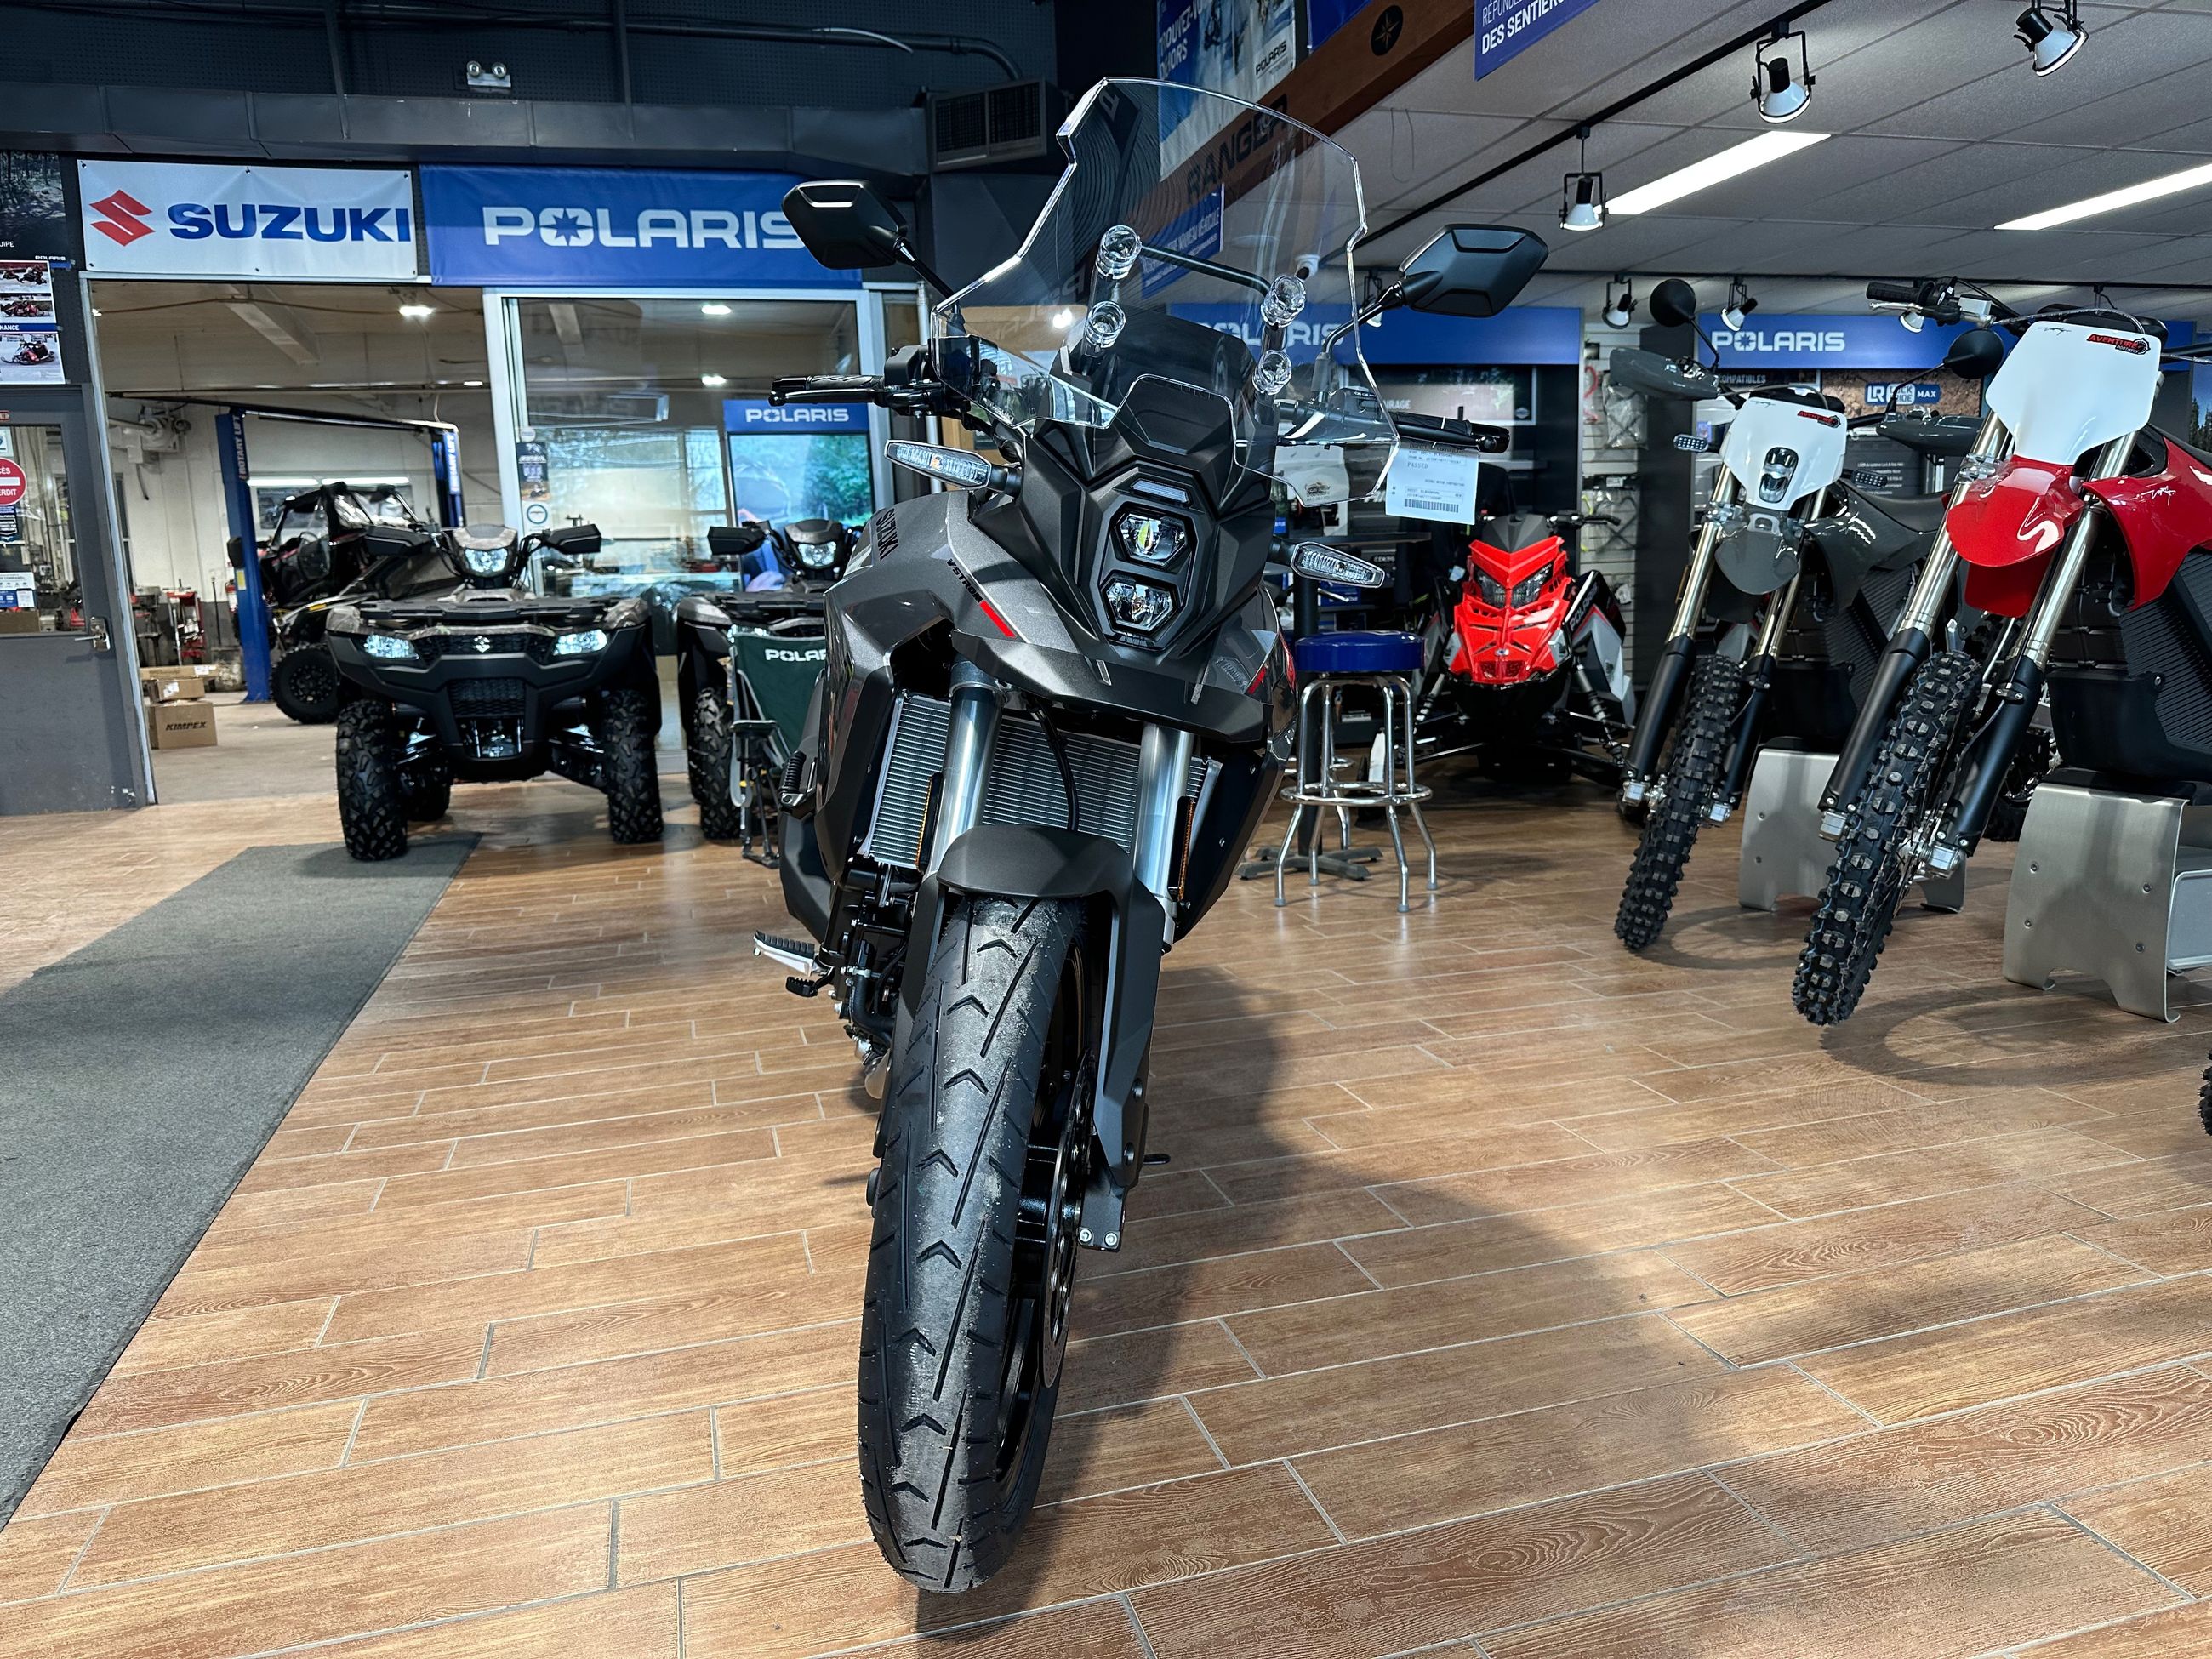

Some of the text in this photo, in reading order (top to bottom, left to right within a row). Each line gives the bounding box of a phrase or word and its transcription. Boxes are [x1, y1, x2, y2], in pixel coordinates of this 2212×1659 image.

[1482, 0, 1565, 55] DES SENTIE
[1256, 41, 1287, 76] POLARIS
[1187, 93, 1288, 204] RANGER
[168, 203, 411, 242] SUZUKI
[482, 207, 807, 249] POLARIS
[1196, 321, 1344, 346] OLRIS
[1711, 331, 1845, 352] POLARIS
[2089, 334, 2139, 350] AVENTURE
[1867, 385, 1885, 402] LR
[1890, 385, 1912, 394] LCK
[1917, 390, 1936, 398] MAX
[232, 414, 242, 436] LIFT
[745, 408, 849, 423] POLARIS
[876, 508, 899, 562] SUZUKI
[165, 721, 207, 732] KIMPEX
